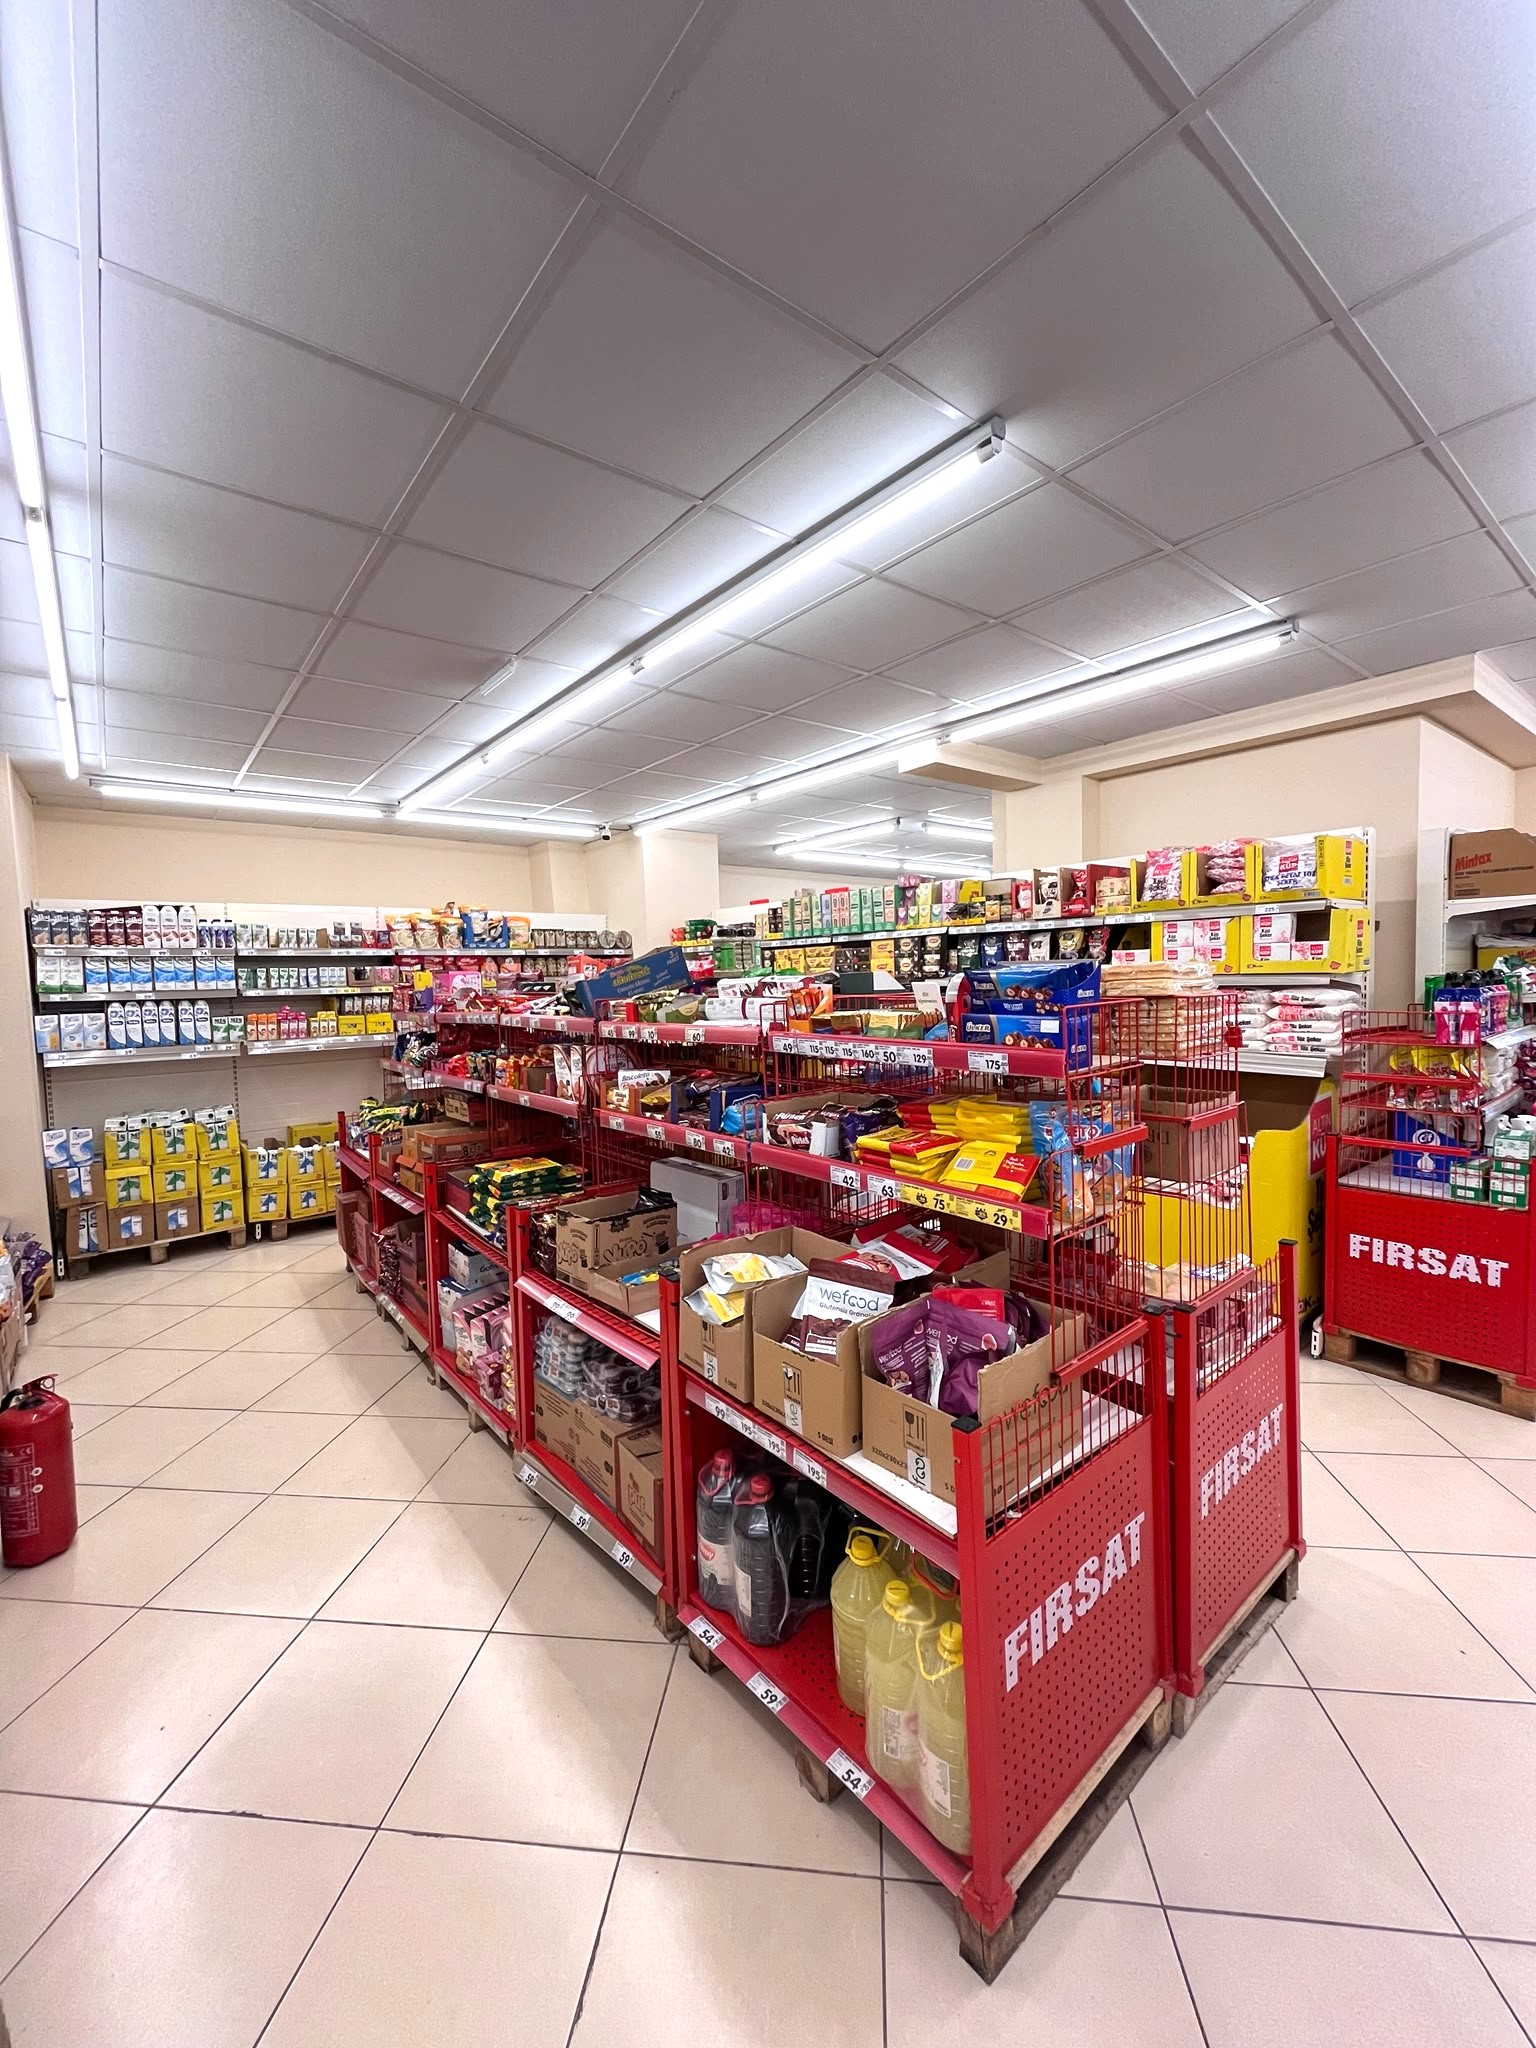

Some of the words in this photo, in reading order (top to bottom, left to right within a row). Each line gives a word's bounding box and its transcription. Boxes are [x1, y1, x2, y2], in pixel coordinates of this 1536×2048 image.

[1455, 852, 1492, 872] Mintax
[966, 1022, 991, 1033] ÜLKER
[692, 1033, 701, 1041] 60
[782, 1042, 793, 1052] 49
[809, 1045, 820, 1053] 115
[824, 1046, 835, 1054] 115
[842, 1047, 853, 1057] 115
[861, 1049, 875, 1059] 160
[882, 1050, 896, 1062] 50
[912, 1053, 927, 1063] 129
[985, 1059, 1001, 1070] 175
[721, 1146, 731, 1156] 42
[1312, 1139, 1326, 1161] KÜ
[842, 1175, 855, 1187] 42
[881, 1185, 894, 1198] 63
[932, 1197, 946, 1210] 75
[993, 1212, 1008, 1227] 29
[1349, 1233, 1510, 1288] FIRSAT
[819, 1286, 880, 1311] wefood
[819, 1300, 849, 1314] Glutensiz
[715, 1405, 726, 1420] 99
[740, 1421, 753, 1436] 195
[767, 1438, 781, 1454] 195
[1200, 1403, 1284, 1520] FIRSAT
[525, 1472, 535, 1484] 59
[807, 1463, 822, 1481] 195
[576, 1515, 587, 1527] 59
[619, 1551, 631, 1564] 59
[1004, 1511, 1145, 1692] FIRSAT
[698, 1628, 715, 1644] 54
[760, 1687, 778, 1705] 59
[841, 1769, 863, 1790] 54
